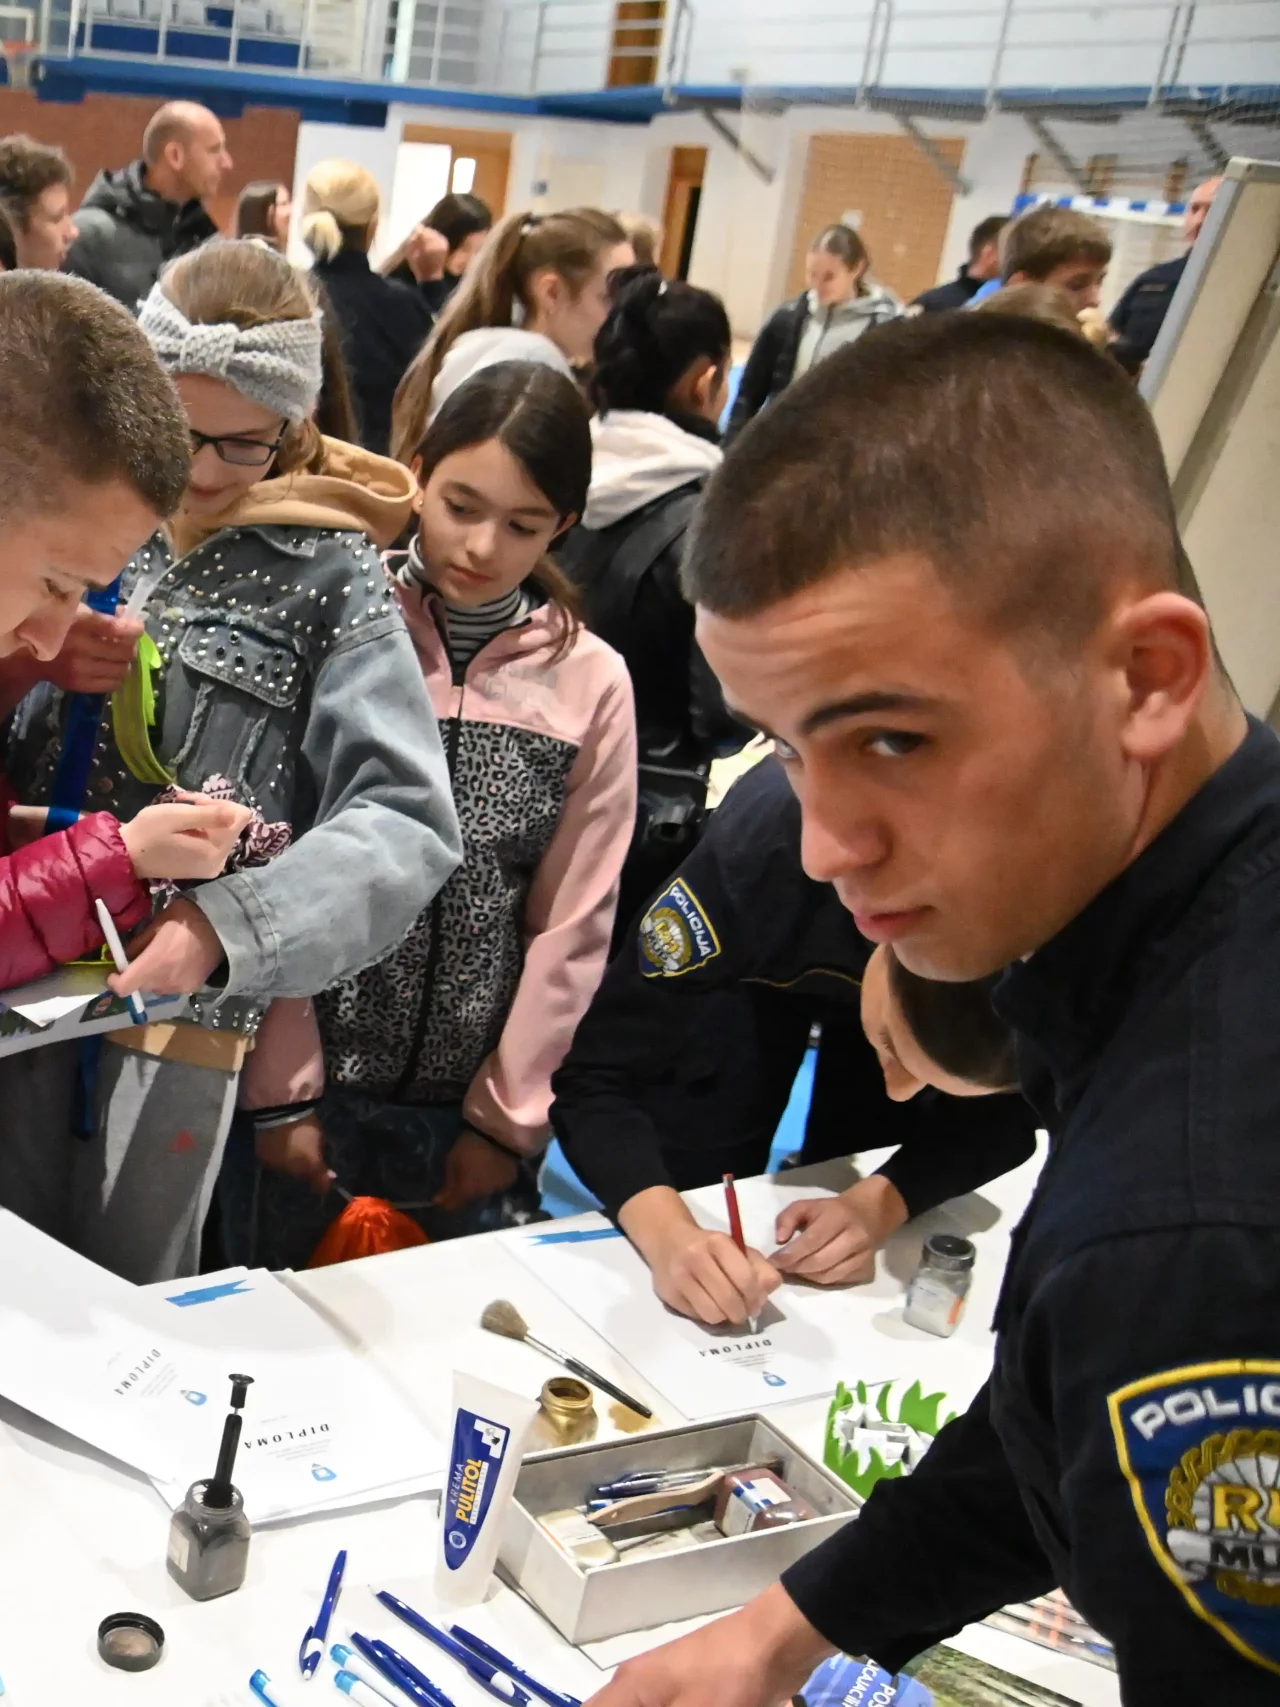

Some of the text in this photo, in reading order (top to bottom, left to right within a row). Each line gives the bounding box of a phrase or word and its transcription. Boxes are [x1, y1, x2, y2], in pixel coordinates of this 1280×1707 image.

[669, 886, 712, 957] POLICIJA
[698, 1339, 772, 1357] DIPLOMA
[114, 1348, 161, 1395] DIPLOMA
[244, 1423, 330, 1450] DIPLOMA
[450, 1463, 464, 1506] KREMA
[455, 1459, 483, 1523] PULITOL
